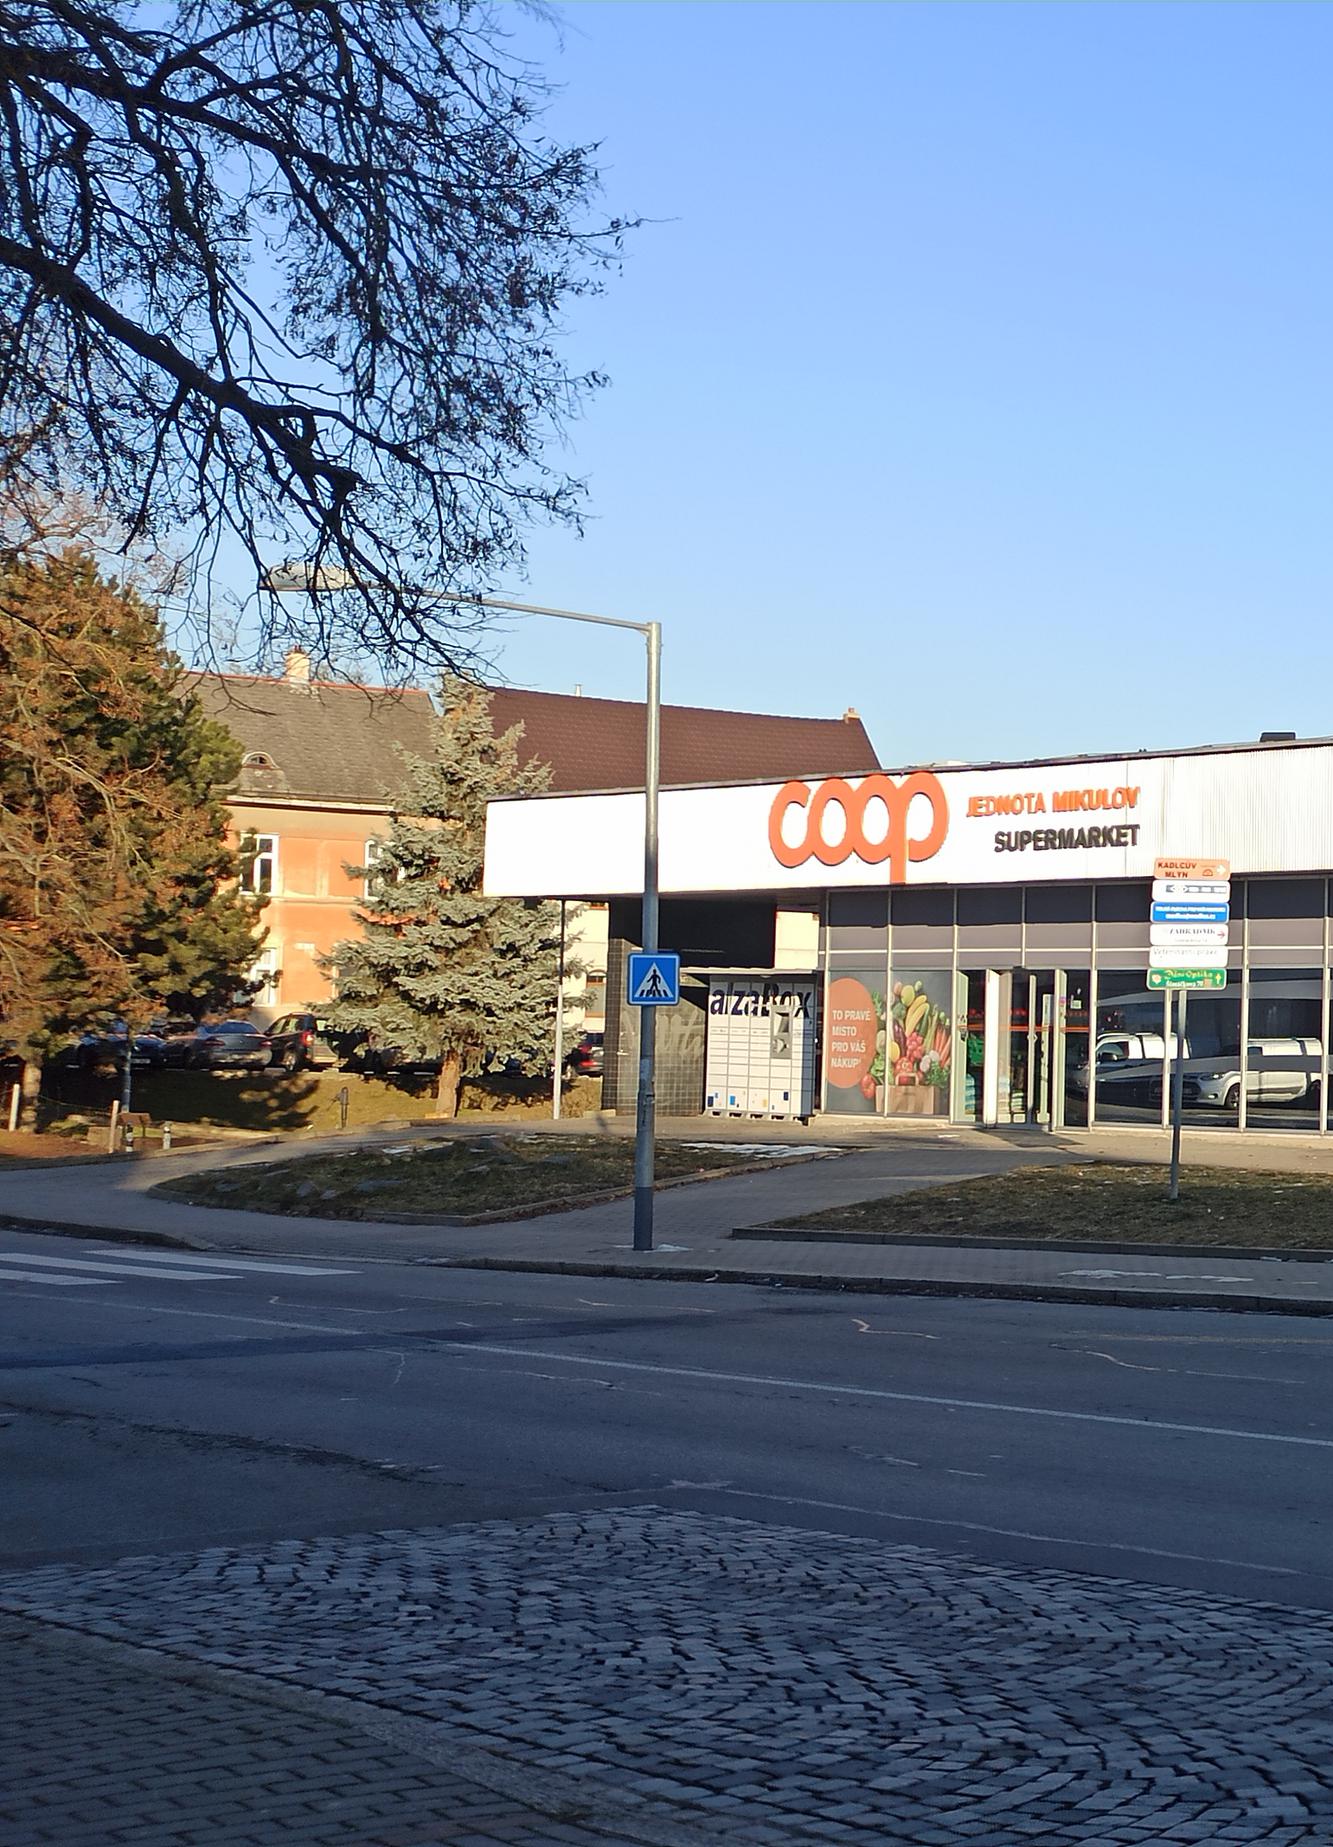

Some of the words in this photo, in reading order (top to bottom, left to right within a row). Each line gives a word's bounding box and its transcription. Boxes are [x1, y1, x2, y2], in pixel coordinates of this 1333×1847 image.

[966, 792, 1046, 818] JEDNOTA
[1052, 786, 1141, 813] MIKULOV
[994, 824, 1141, 853] SUPERMARKET
[832, 1010, 843, 1020] TO
[831, 1041, 849, 1052] PRO
